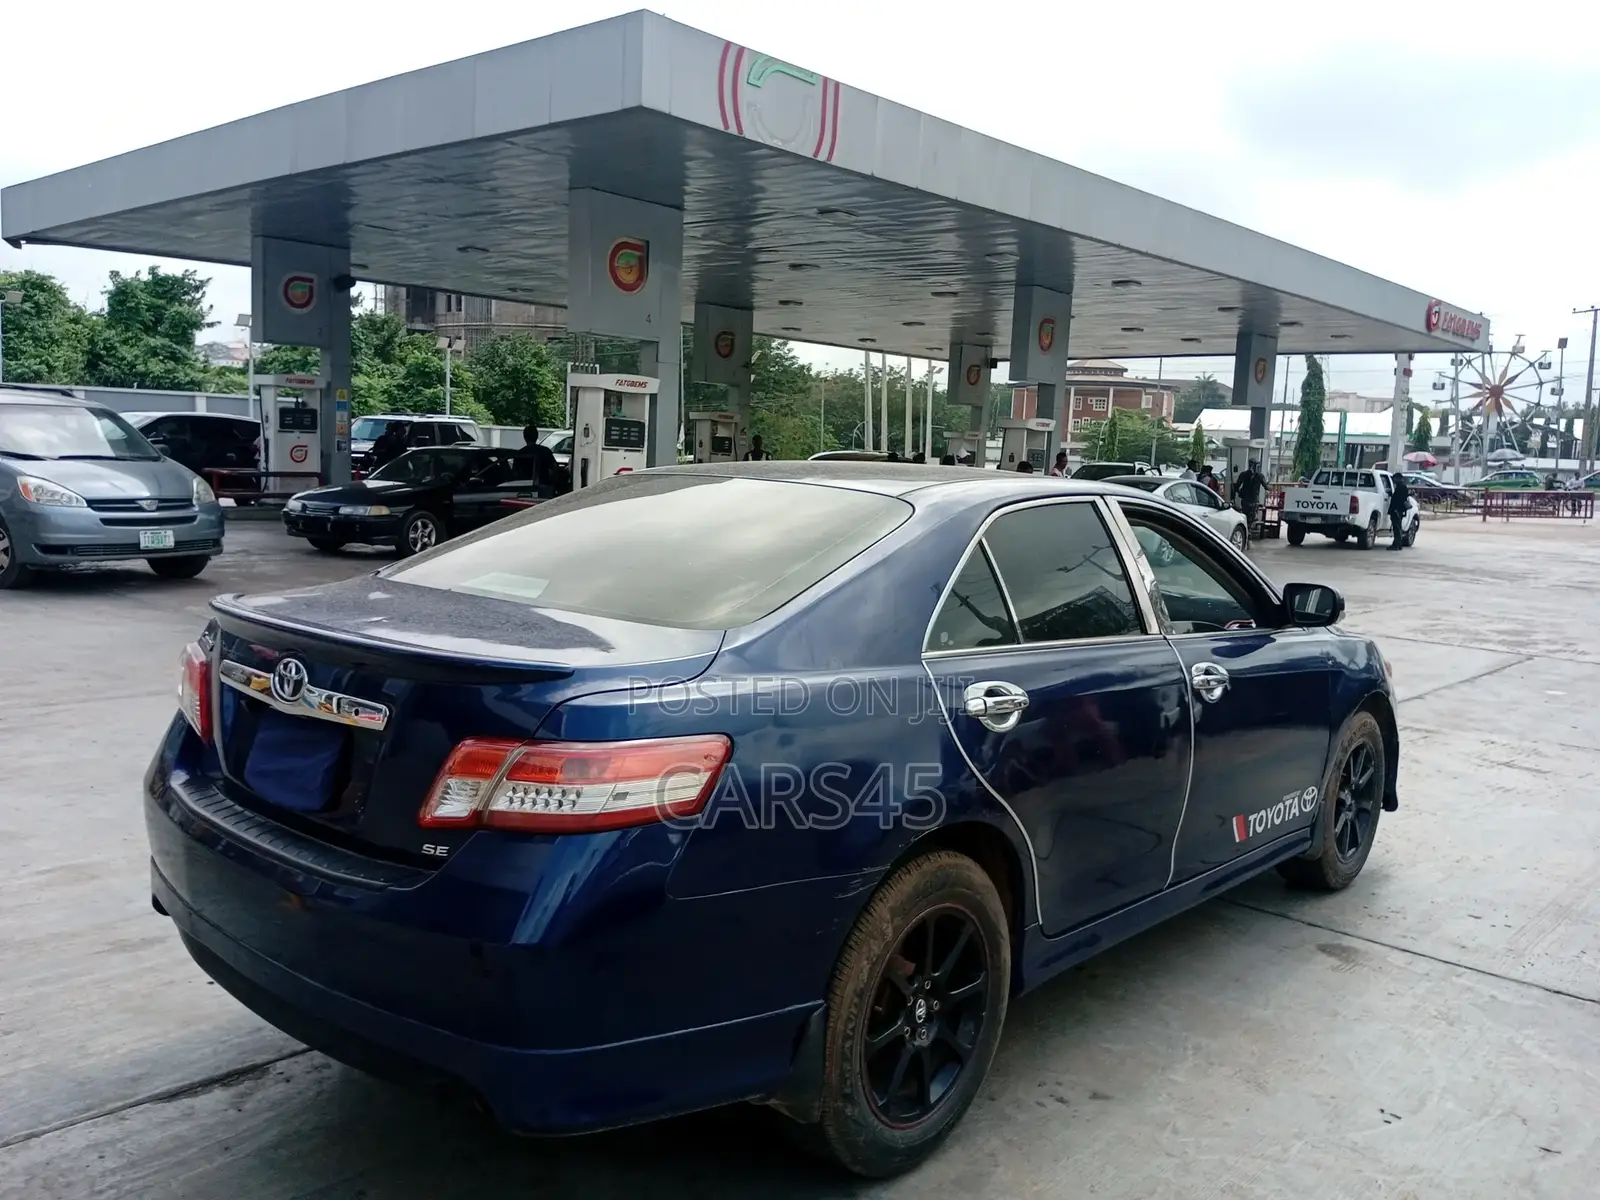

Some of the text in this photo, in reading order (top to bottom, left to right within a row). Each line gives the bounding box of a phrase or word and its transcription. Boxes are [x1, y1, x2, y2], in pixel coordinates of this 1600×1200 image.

[1295, 500, 1338, 511] TOYOTA
[1248, 796, 1300, 837] TOYOTA
[421, 843, 450, 857] SE
